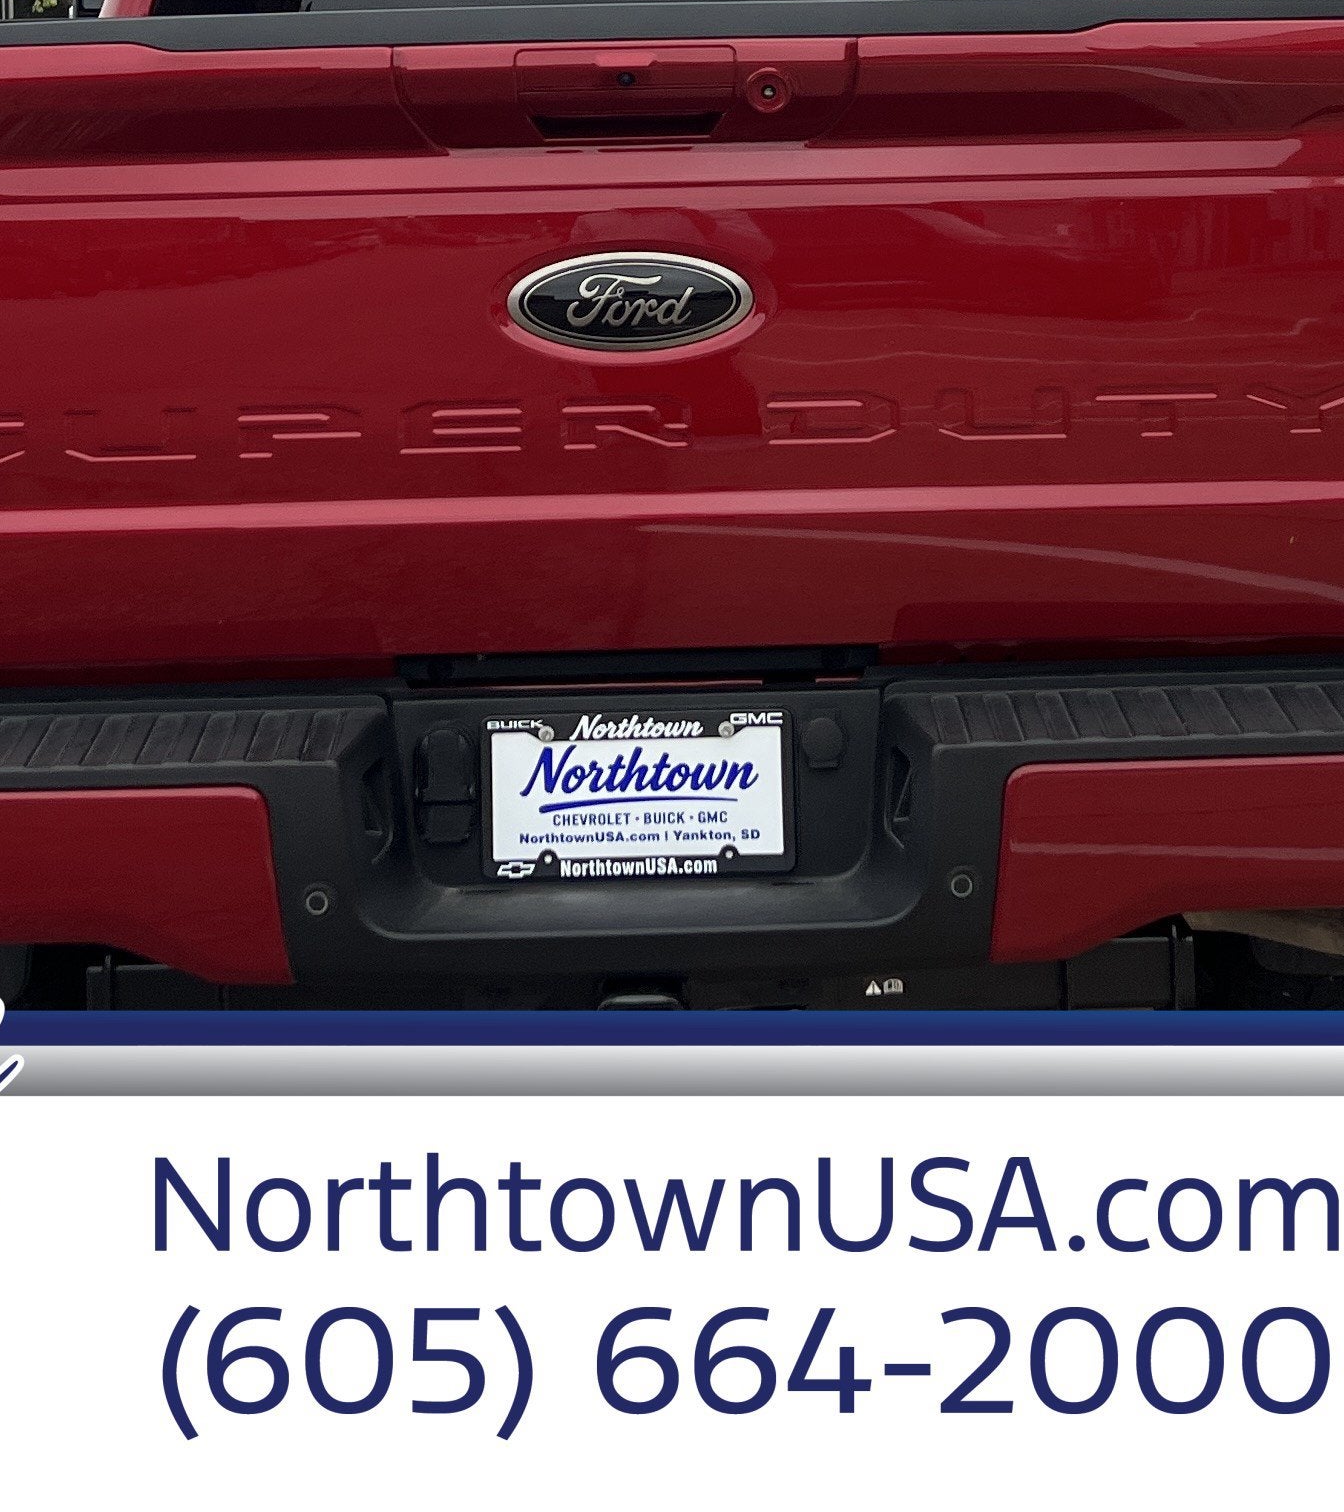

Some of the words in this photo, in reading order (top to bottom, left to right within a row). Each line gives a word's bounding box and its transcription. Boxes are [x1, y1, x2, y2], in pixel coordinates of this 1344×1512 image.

[566, 273, 695, 327] Ford
[486, 719, 544, 731] BUICK
[569, 714, 704, 741] Northtown
[729, 711, 784, 725] GMC
[519, 744, 759, 798] Northtown
[552, 813, 632, 827] CHEVROLET
[643, 811, 686, 825] BUICK
[697, 810, 729, 824] GMC
[519, 831, 661, 845] NorthtownUSA.com
[673, 830, 737, 842] Yankton,
[741, 828, 762, 840] SD
[559, 857, 719, 878] NorthtownUSA.com
